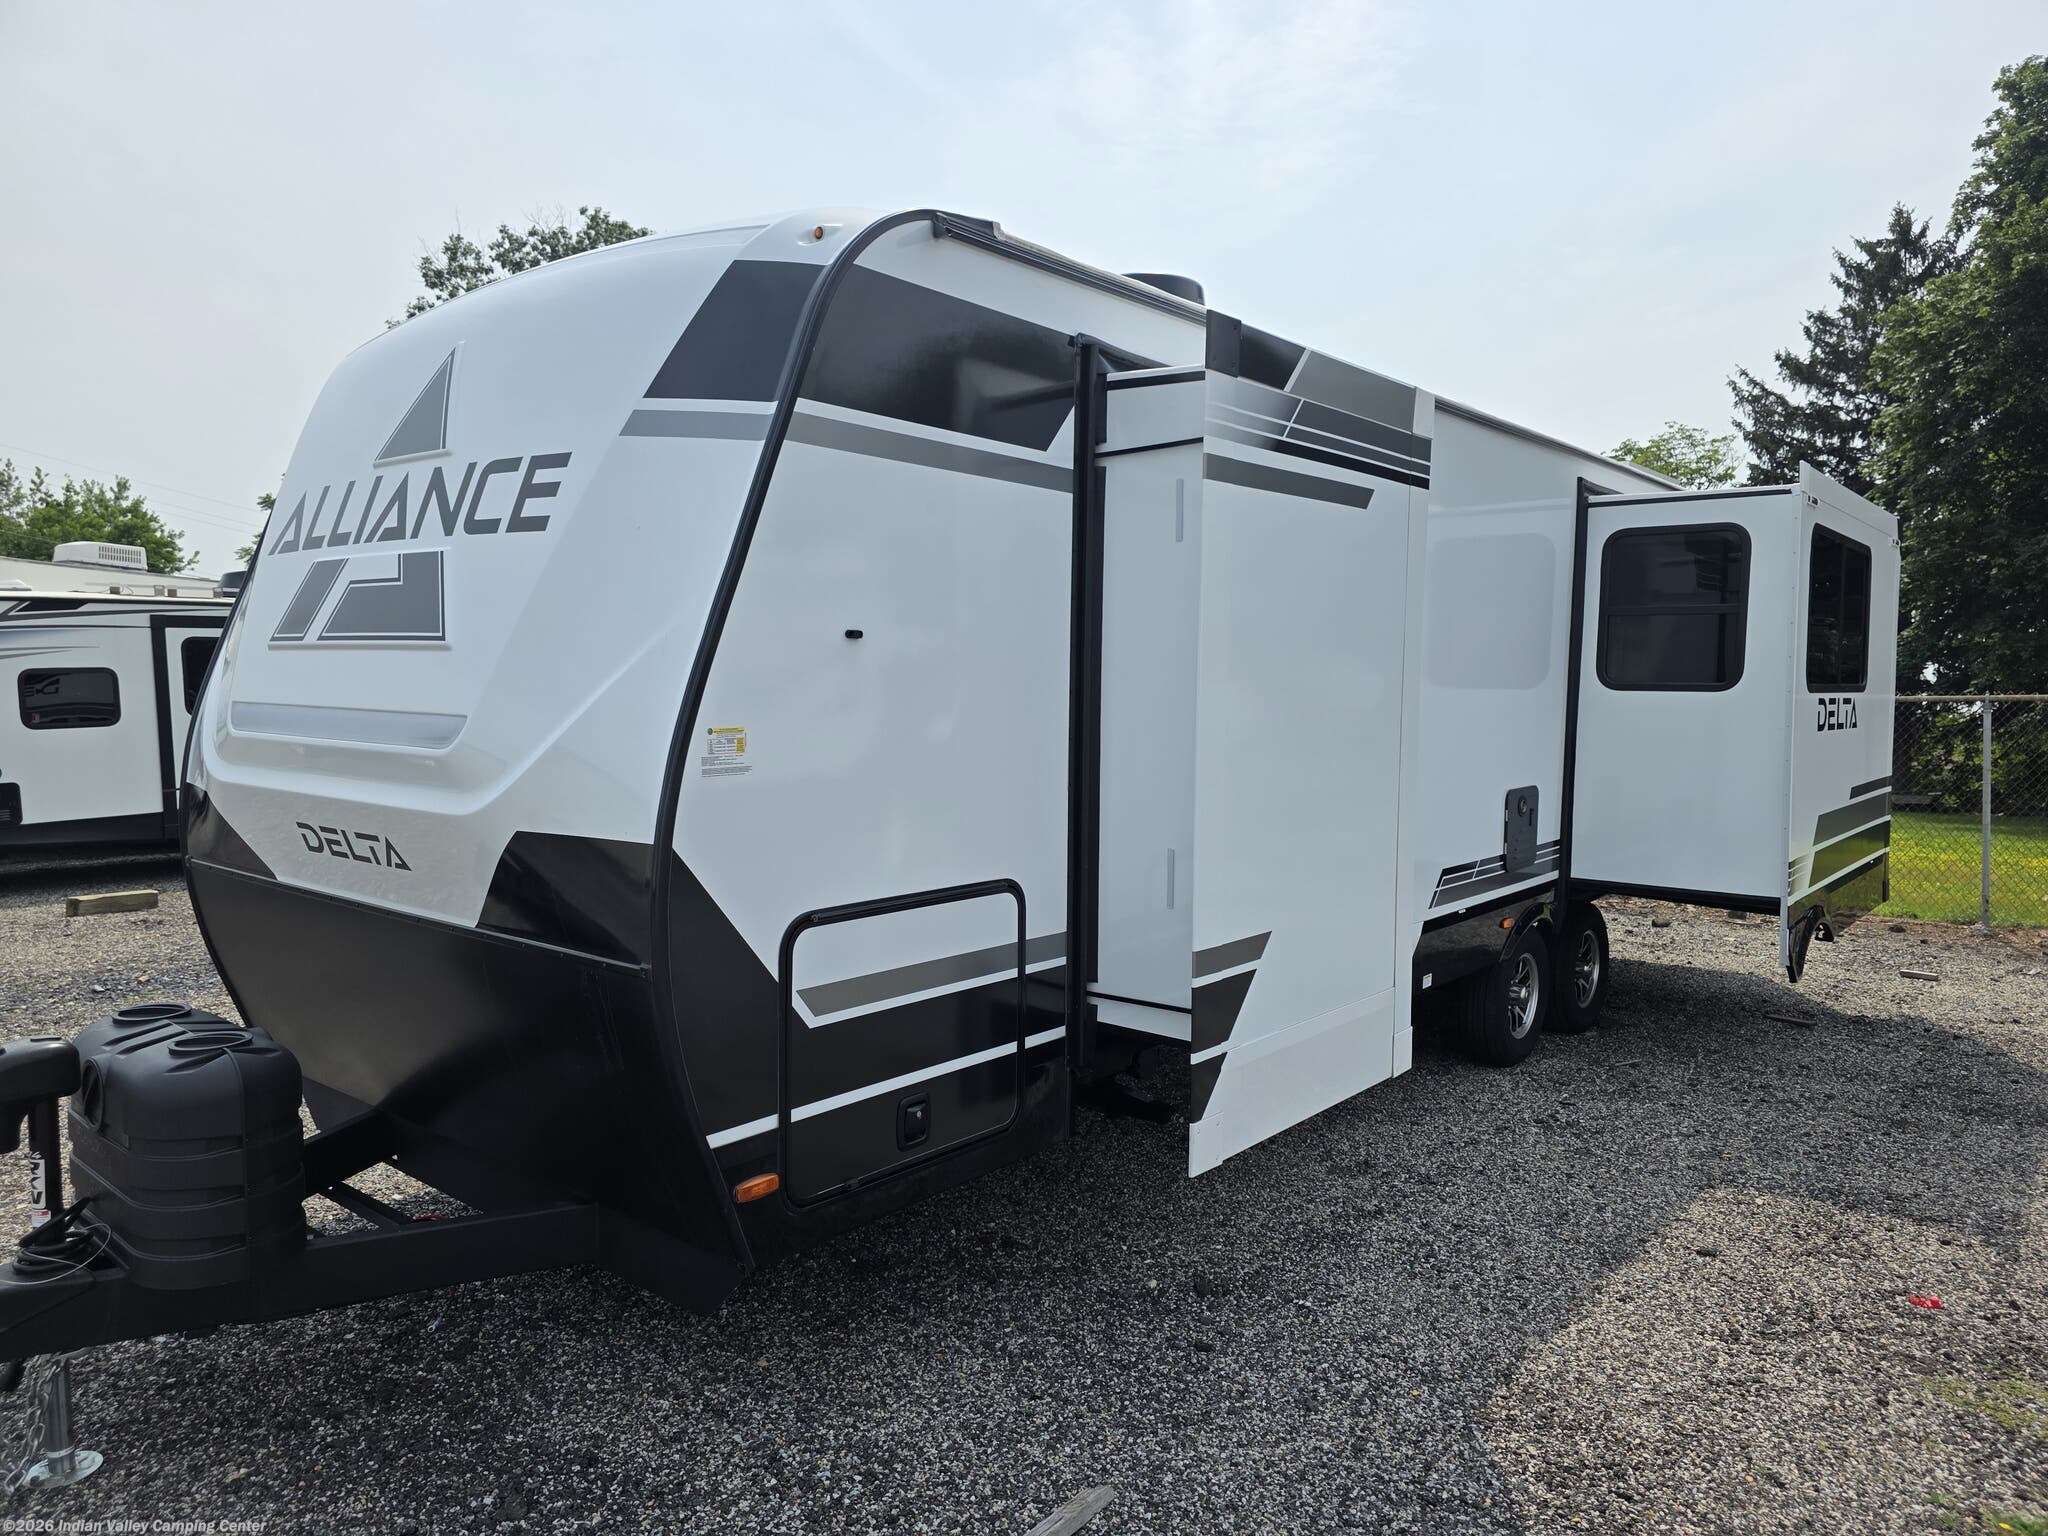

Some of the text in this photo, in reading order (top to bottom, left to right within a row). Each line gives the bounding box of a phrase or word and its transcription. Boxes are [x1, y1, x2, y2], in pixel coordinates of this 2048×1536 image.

[267, 451, 573, 556] ALLIANCE
[1817, 697, 1858, 732] DELTA
[295, 821, 413, 872] DELTA
